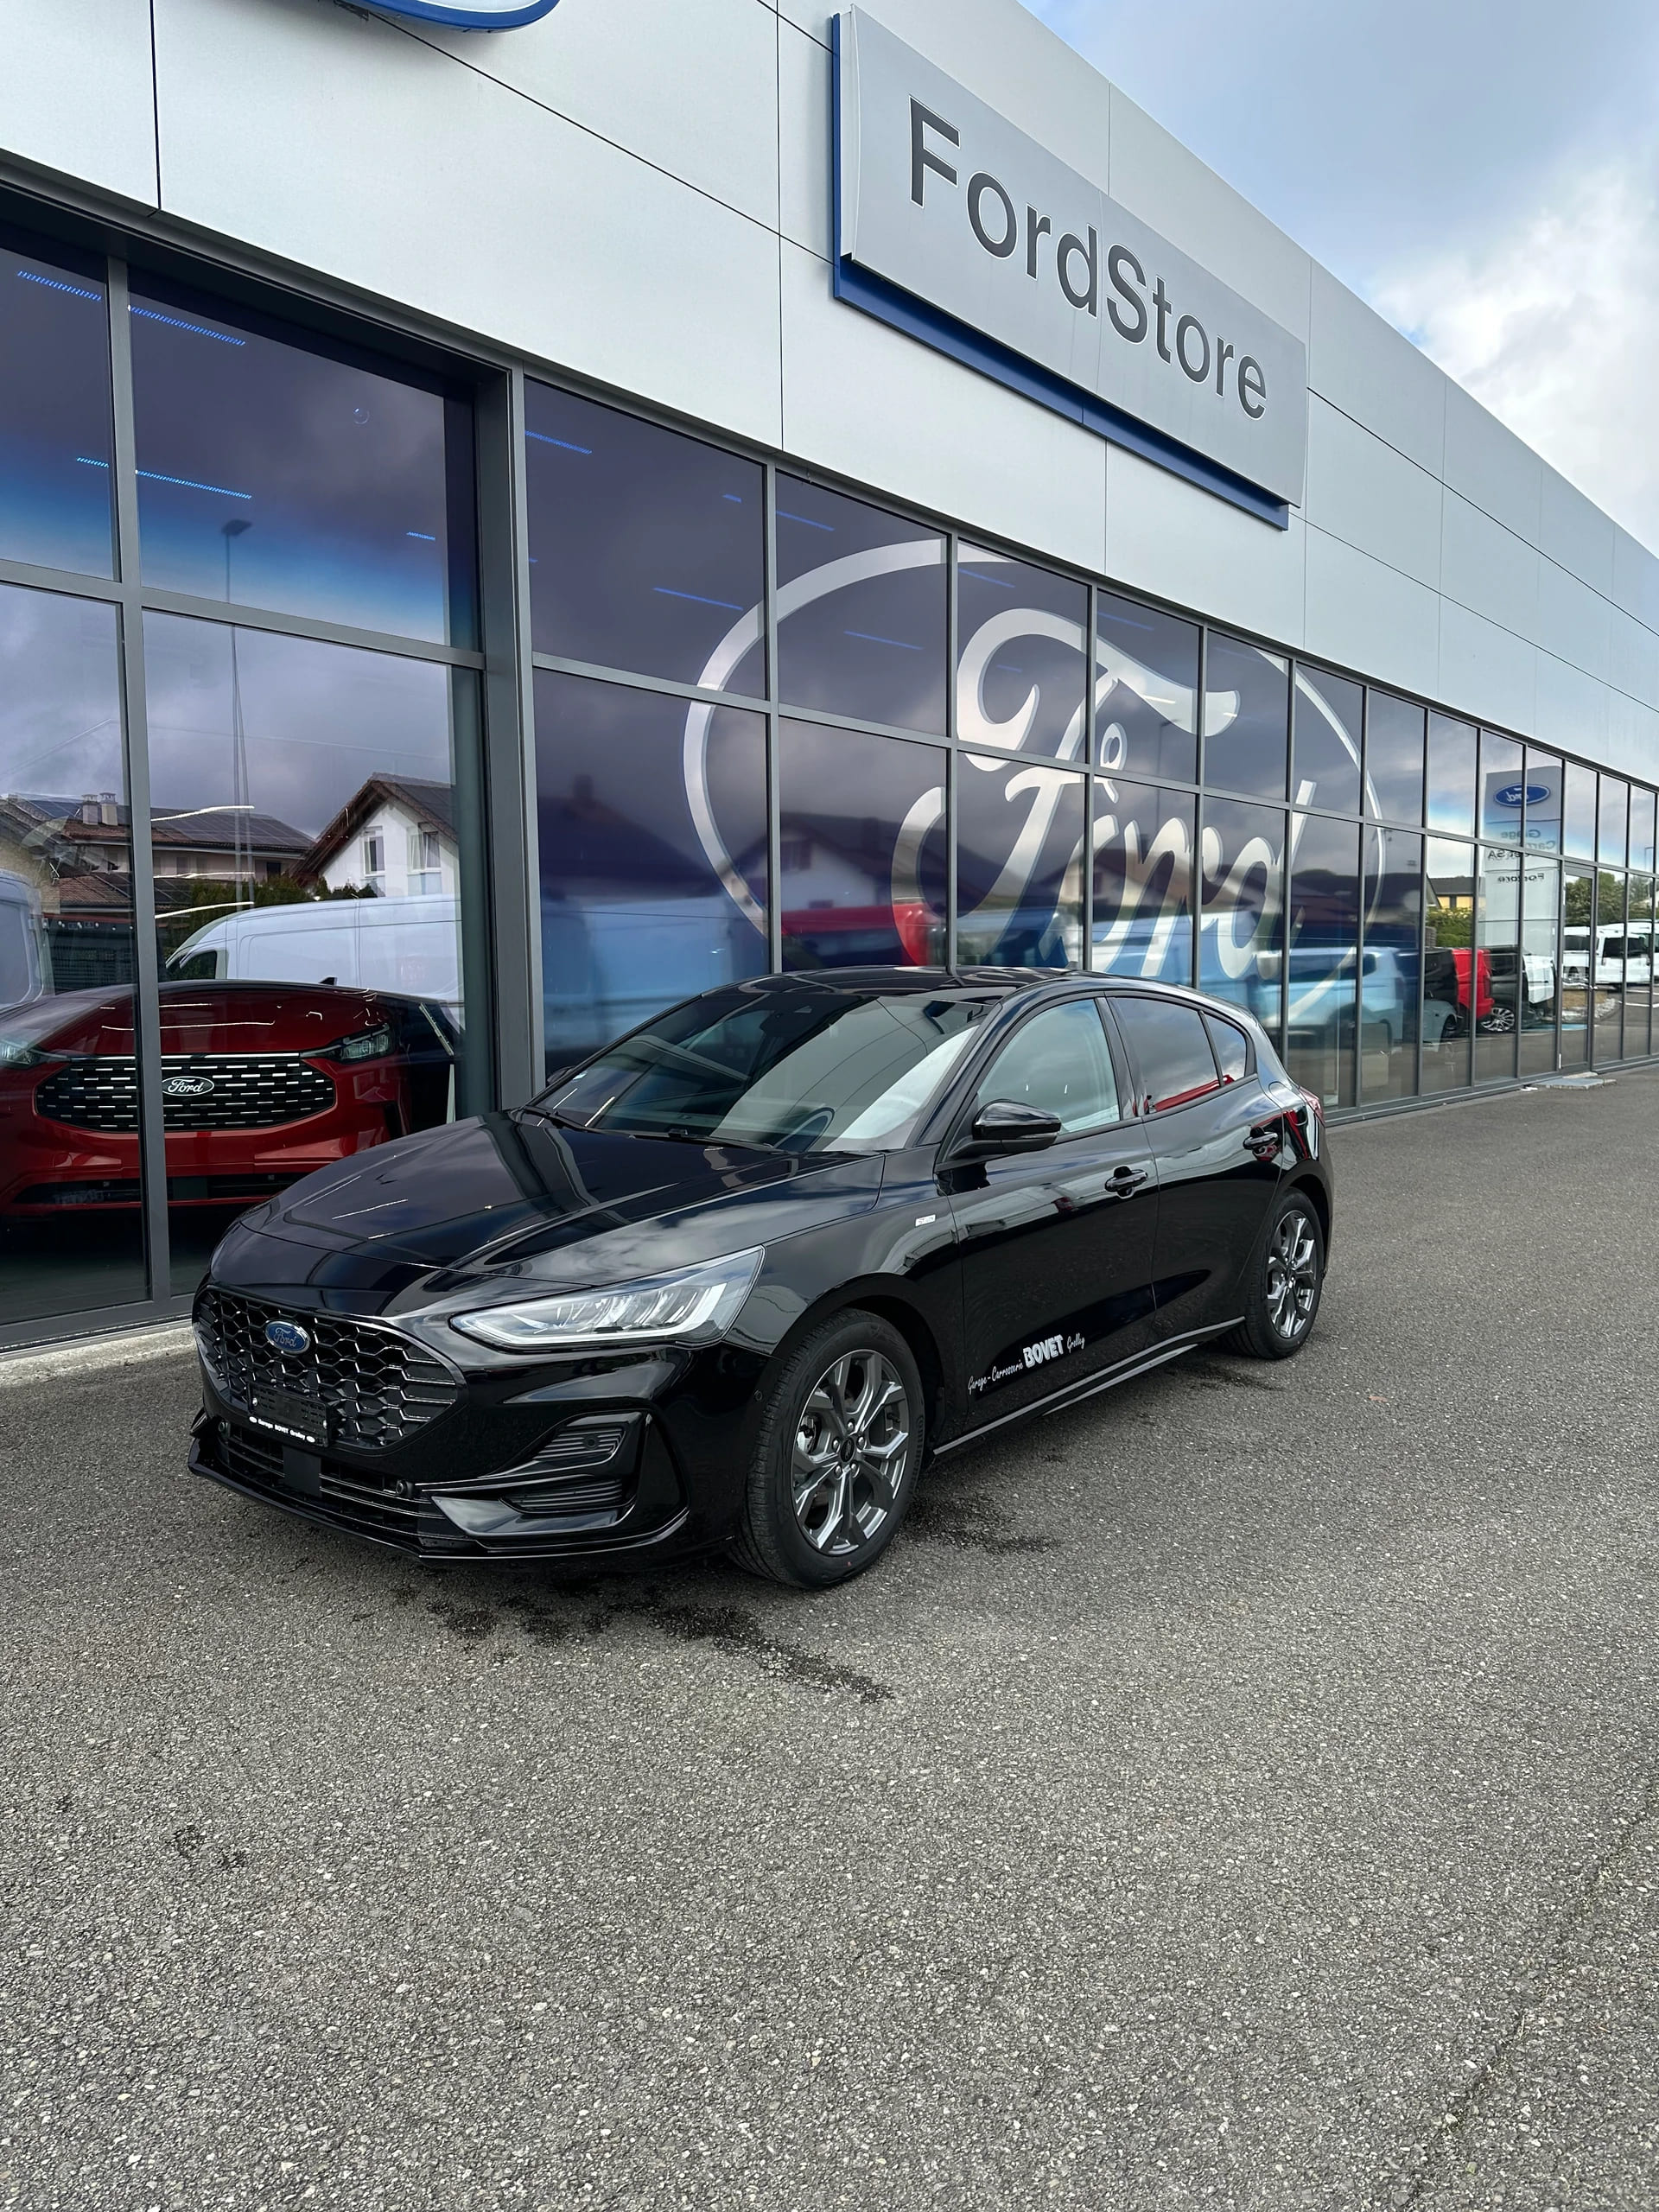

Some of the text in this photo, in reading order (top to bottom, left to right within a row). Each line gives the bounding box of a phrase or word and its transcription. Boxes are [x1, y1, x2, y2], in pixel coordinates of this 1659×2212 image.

[908, 94, 1268, 421] FordStore
[891, 607, 1317, 981] Ford
[168, 1078, 204, 1093] Ford
[1022, 1334, 1064, 1369] BOVET
